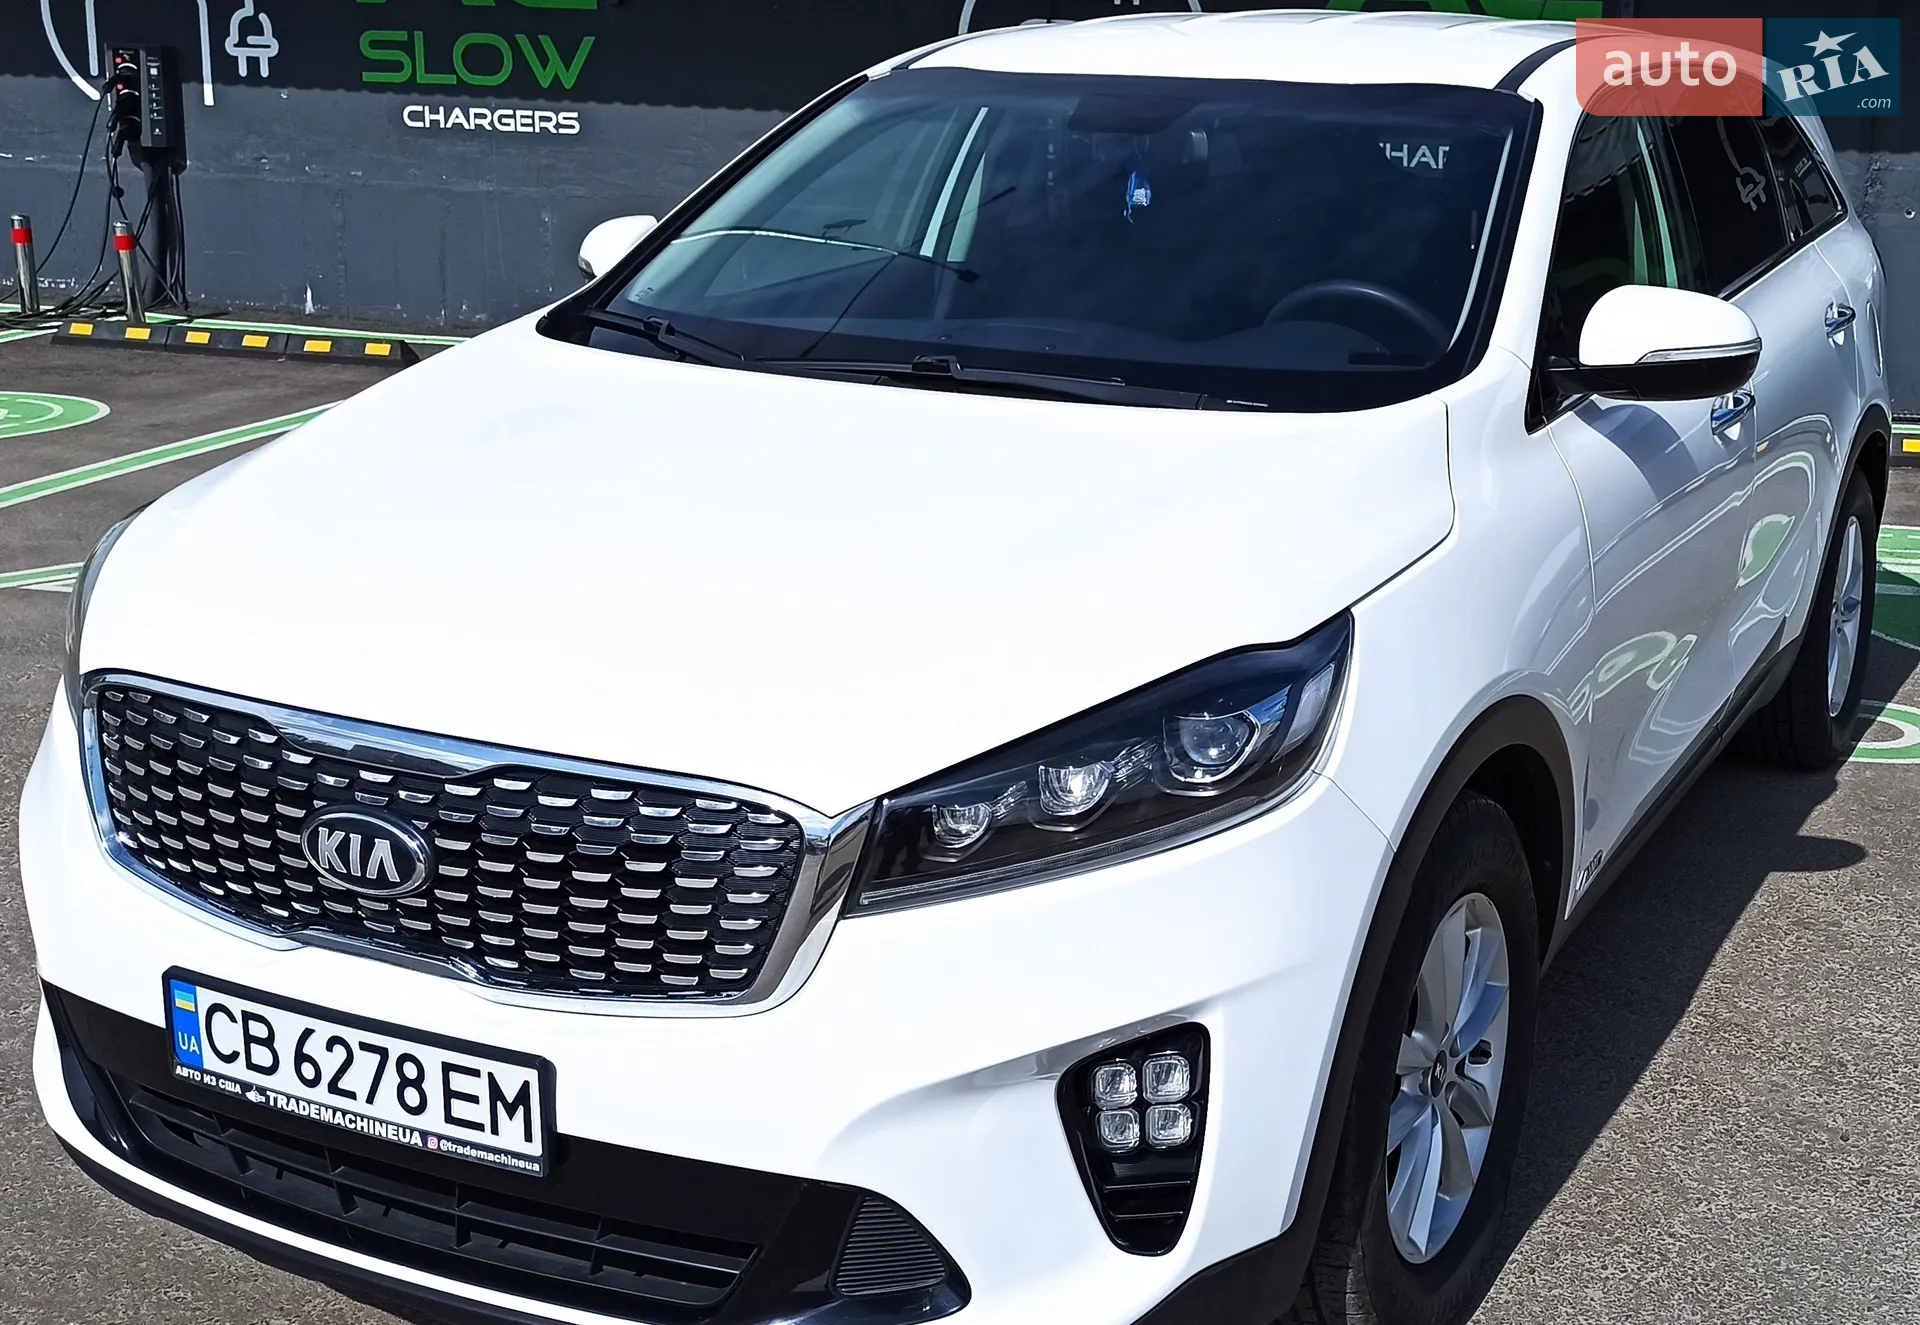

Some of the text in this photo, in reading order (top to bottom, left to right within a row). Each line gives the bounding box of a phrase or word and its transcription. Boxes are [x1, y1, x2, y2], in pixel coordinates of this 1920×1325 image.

[360, 30, 595, 89] SLOW
[403, 105, 580, 134] CHARGERS
[318, 827, 400, 882] KIA
[178, 1031, 200, 1055] UA
[175, 1065, 242, 1095] АВТО ИЗ США
[205, 1002, 533, 1144] CB 6278 EM
[266, 1090, 423, 1148] TRADEMACHINEUA
[439, 1139, 540, 1172] @trademachineua
